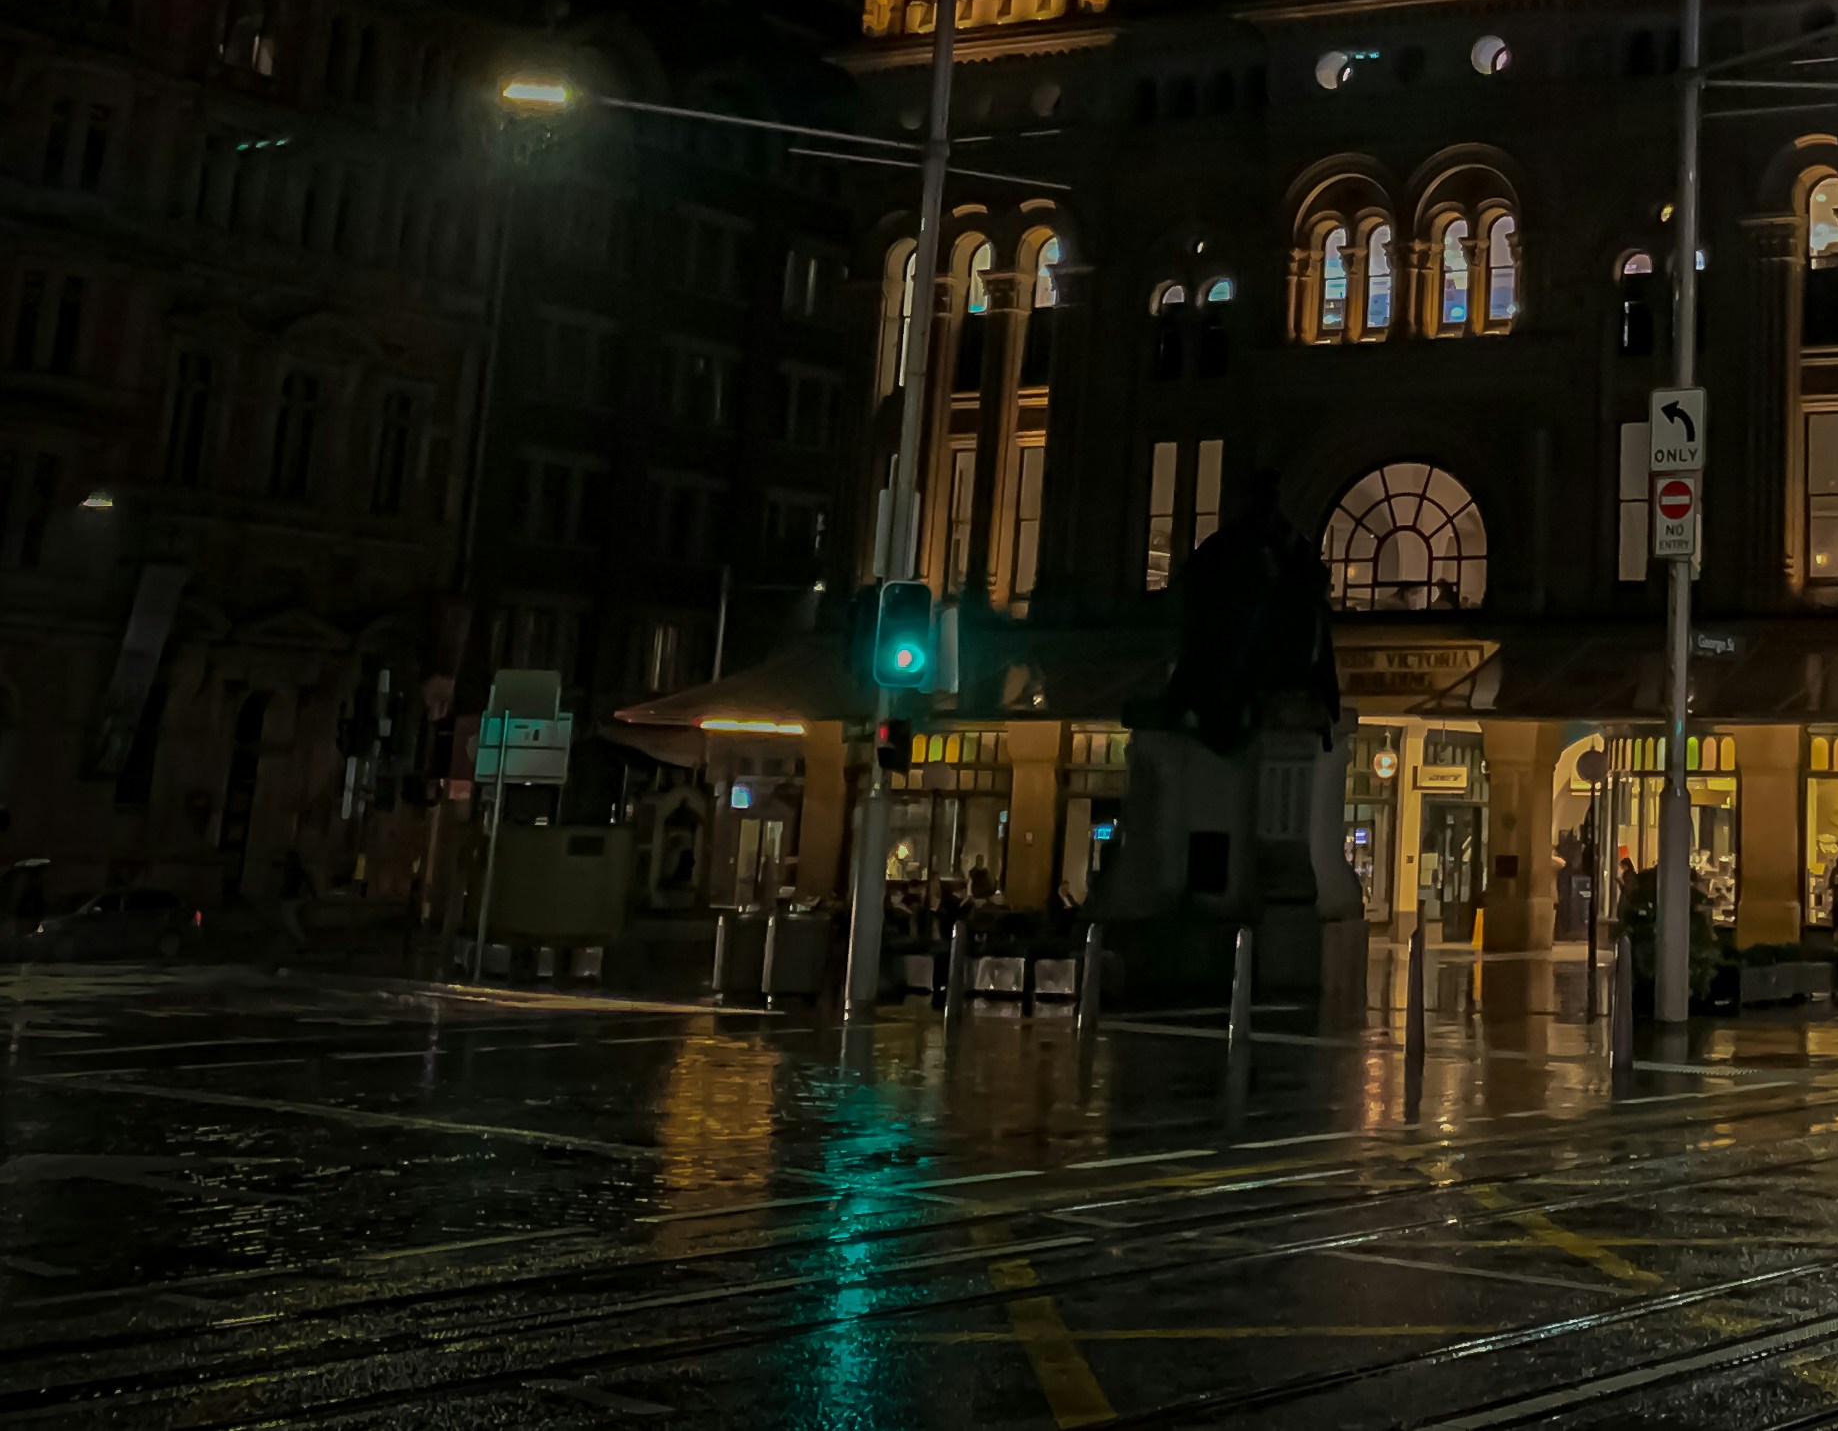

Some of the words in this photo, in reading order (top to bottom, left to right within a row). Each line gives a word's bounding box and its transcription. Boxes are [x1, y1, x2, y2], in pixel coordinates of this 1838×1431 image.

[1654, 449, 1698, 463] ONLY
[1665, 523, 1684, 536] NO
[1658, 539, 1689, 550] ENTRY
[1385, 649, 1472, 669] VICTORIA
